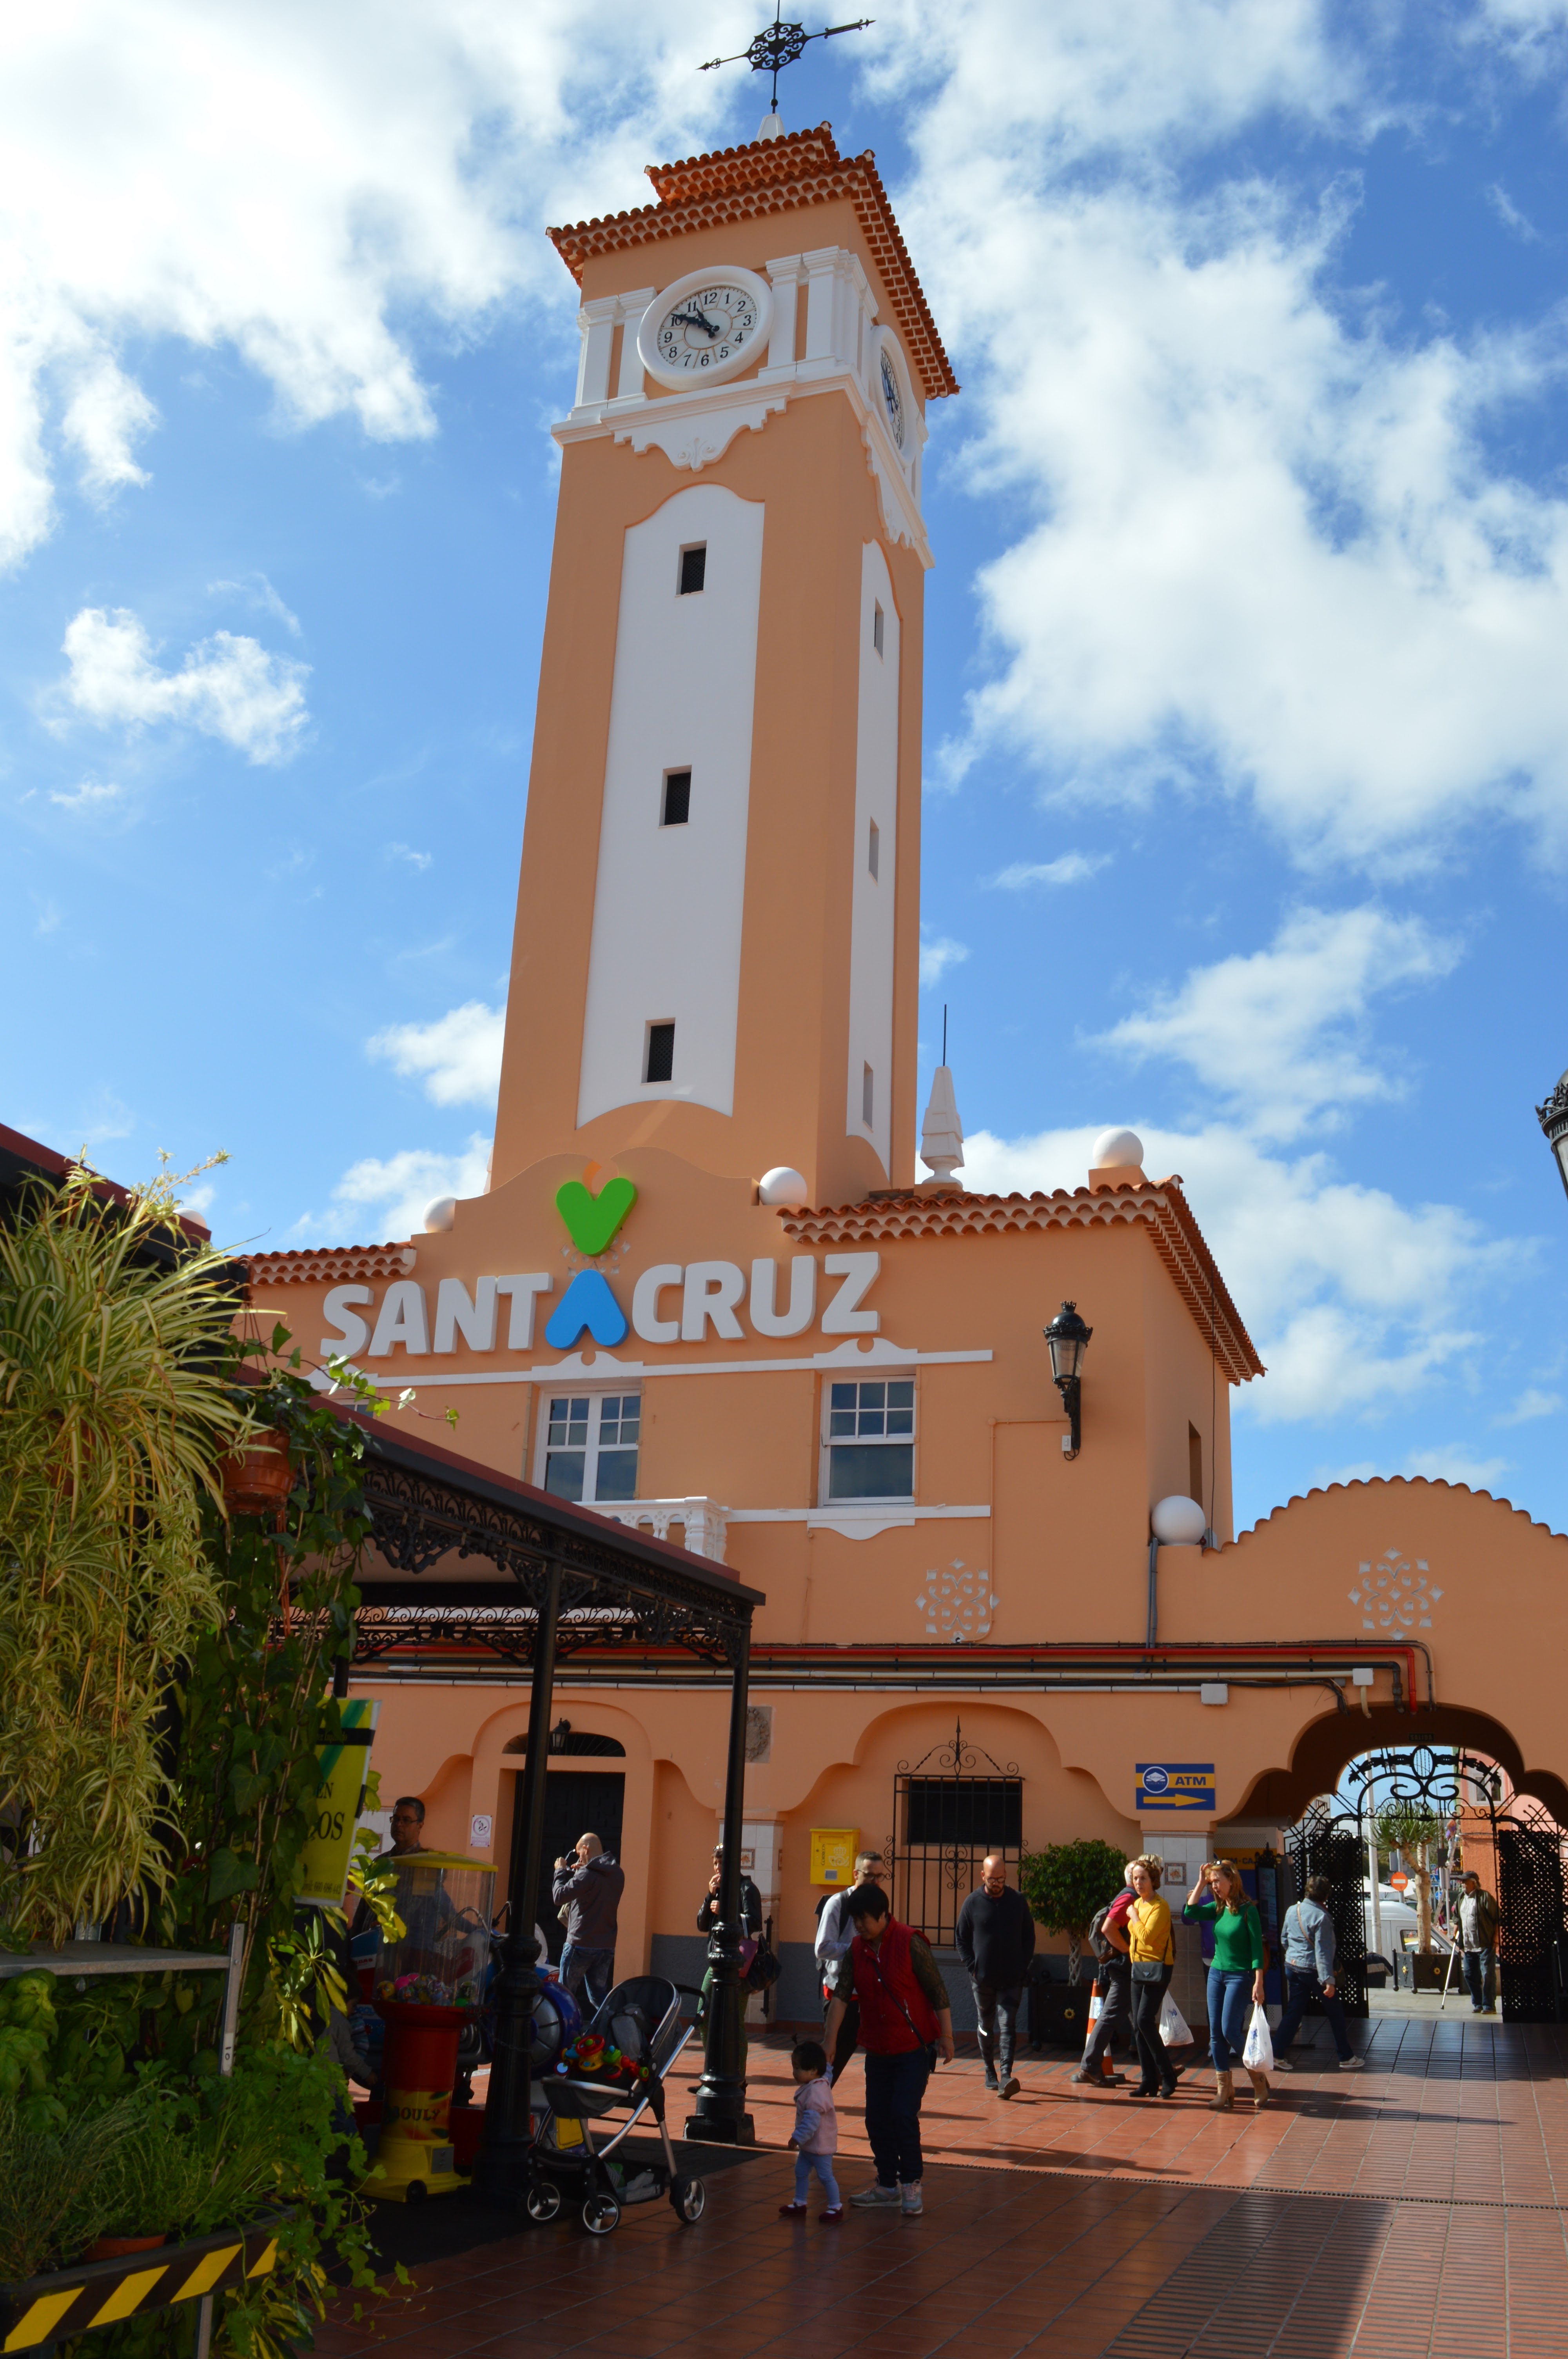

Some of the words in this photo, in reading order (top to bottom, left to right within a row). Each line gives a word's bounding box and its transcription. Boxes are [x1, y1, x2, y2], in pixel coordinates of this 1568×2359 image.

[704, 292, 717, 305] 12
[725, 293, 730, 304] 1
[687, 300, 697, 313] 11
[737, 301, 746, 312] 2
[743, 315, 751, 326] 3
[664, 332, 673, 343] 9
[735, 332, 743, 343] 4
[669, 347, 677, 358] 8
[720, 346, 729, 358] 5
[683, 354, 691, 367] 7
[701, 354, 709, 366] 6
[632, 1251, 882, 1345] CRUZ
[1175, 1776, 1206, 1785] ATM
